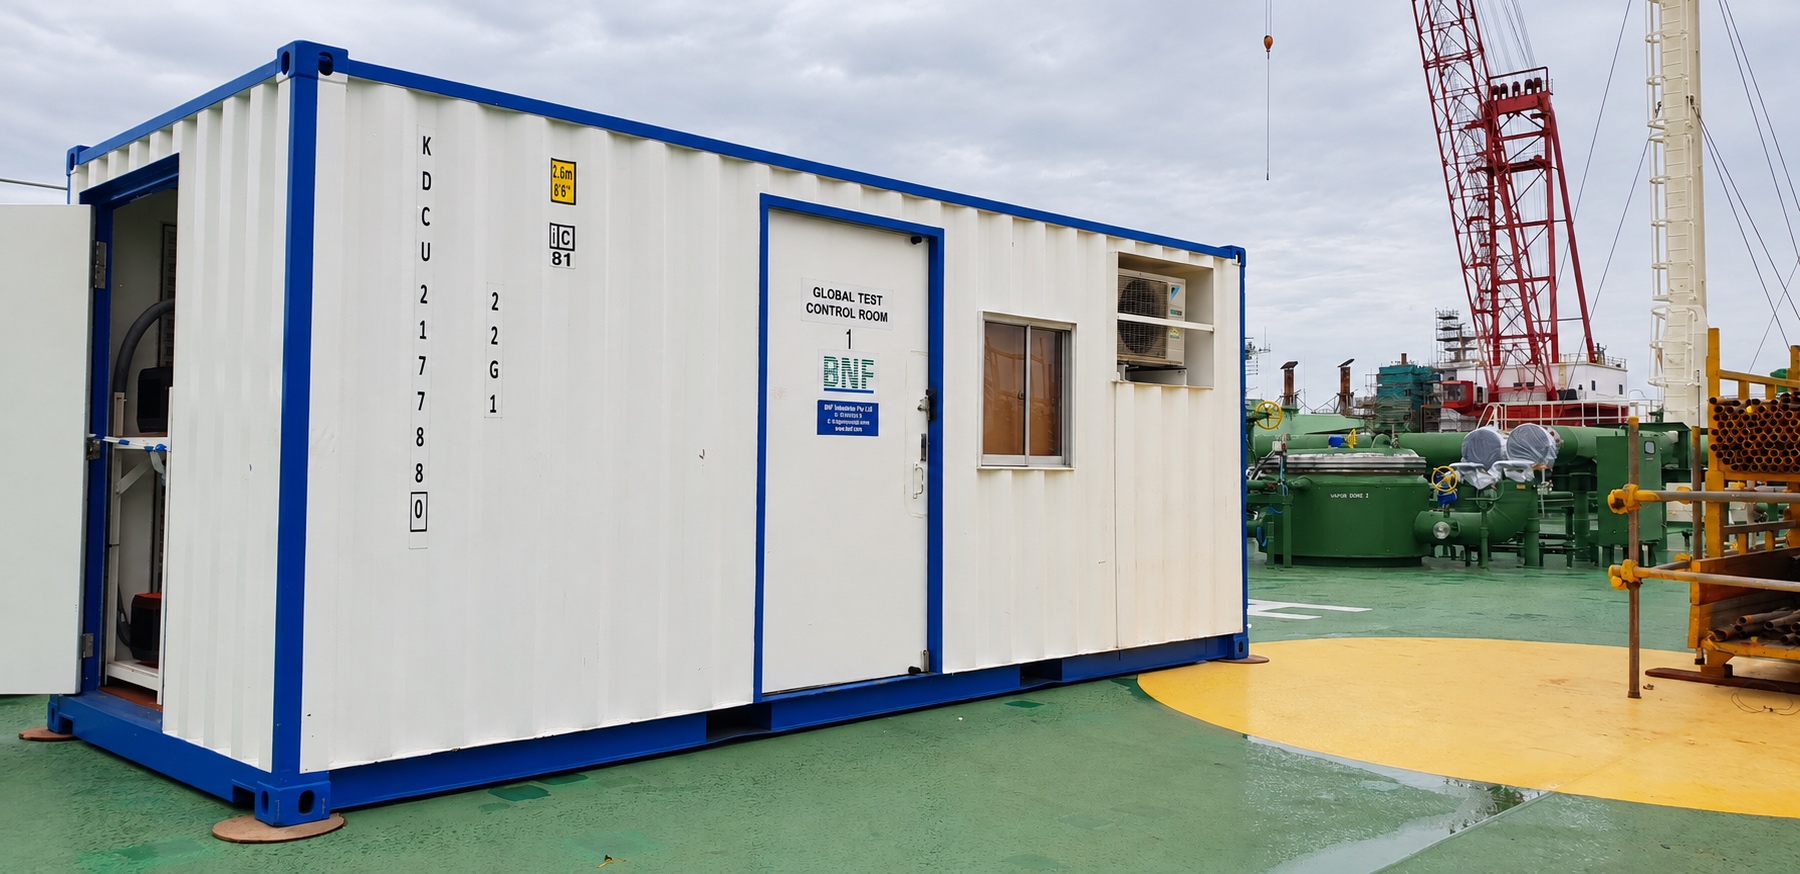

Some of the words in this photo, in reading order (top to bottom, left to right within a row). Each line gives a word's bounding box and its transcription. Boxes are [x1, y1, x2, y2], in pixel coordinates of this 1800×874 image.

[552, 164, 573, 181] 2.6m
[421, 135, 432, 262] KDCU
[552, 251, 571, 267] 81
[813, 286, 855, 303] GLOBAL
[858, 292, 883, 306] TEST
[806, 302, 856, 319] CONTROL
[859, 308, 888, 323] ROOM
[846, 328, 852, 350] 1
[489, 291, 499, 413] 22G1
[823, 355, 875, 389] BNF
